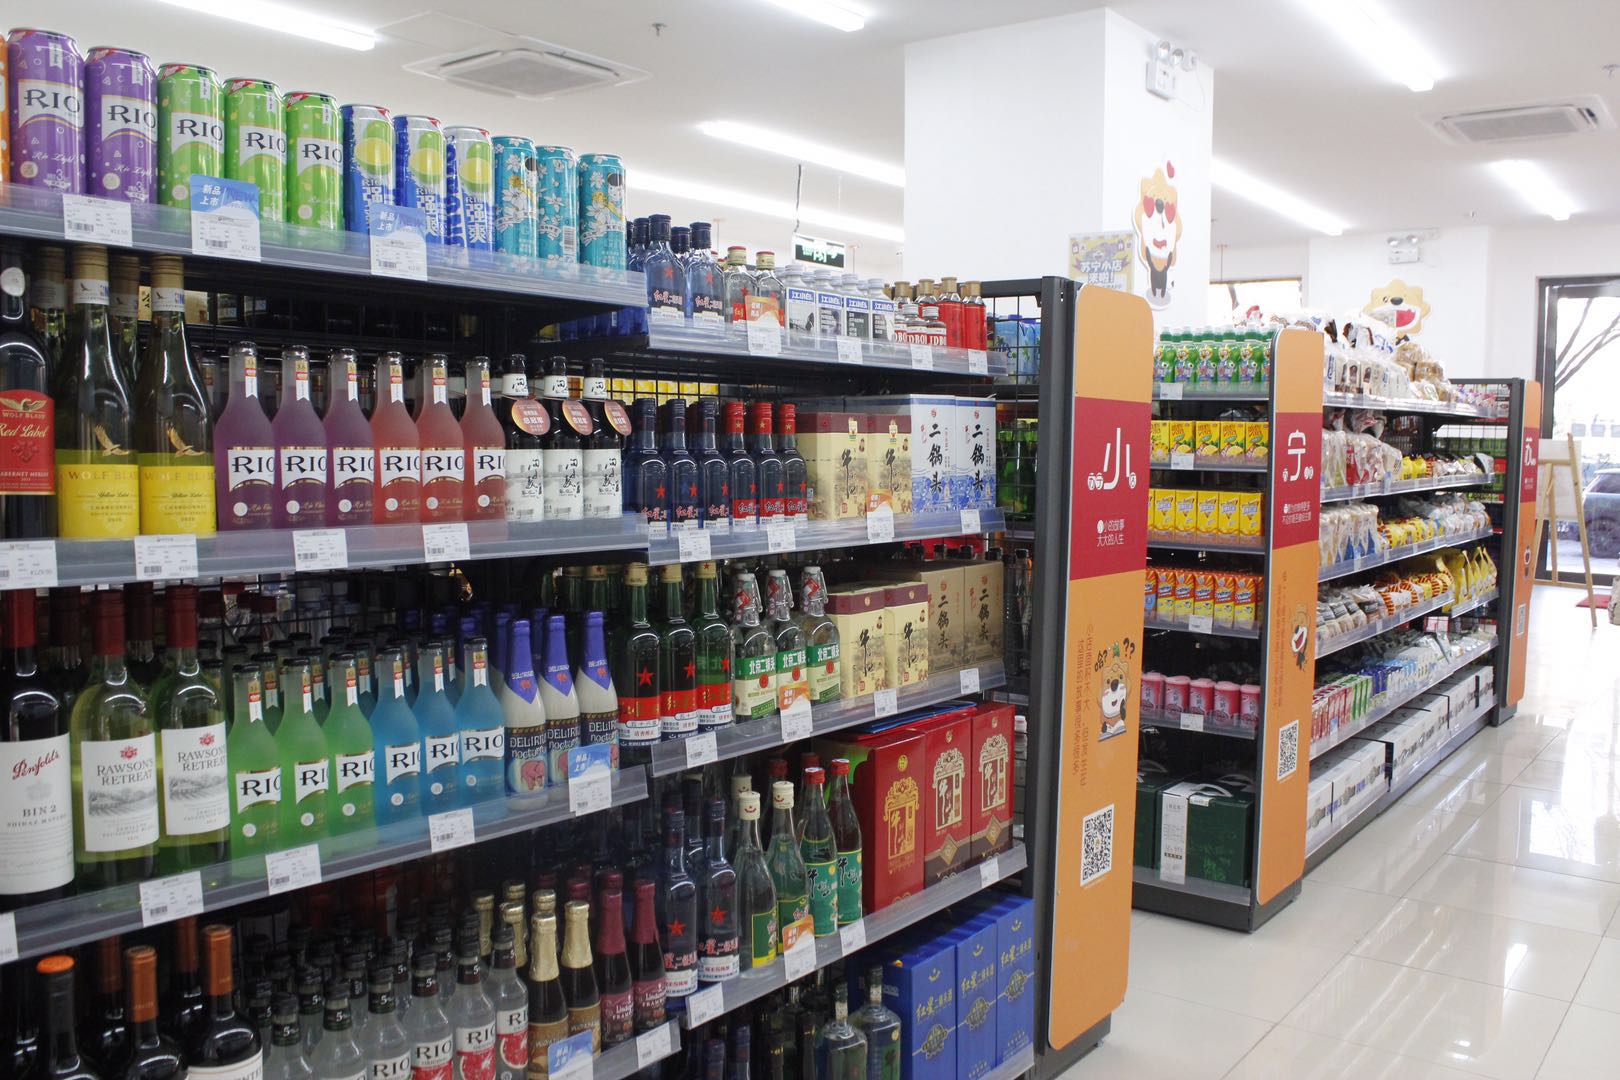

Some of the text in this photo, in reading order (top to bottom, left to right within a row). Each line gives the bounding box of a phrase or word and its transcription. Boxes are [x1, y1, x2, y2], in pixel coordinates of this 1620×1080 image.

[24, 89, 80, 113] RIO
[107, 104, 156, 130] RIO
[177, 119, 223, 142] RIO
[245, 131, 286, 154] RIO
[303, 143, 342, 163] RIO
[201, 183, 221, 196] 新品
[199, 196, 219, 207] 上市
[466, 203, 487, 243] 强爽
[1080, 260, 1123, 272] 苏宁小店
[2, 411, 23, 419] WOLF
[0, 423, 50, 438] Red Label
[232, 456, 275, 474] RIO
[285, 456, 326, 473] RIO
[425, 455, 464, 472] RIO
[928, 423, 943, 494] 二锅头
[970, 424, 985, 492] 二锅头
[937, 594, 950, 650] 二锅头
[978, 588, 990, 642] 二锅头
[464, 733, 504, 753] RIO
[12, 749, 59, 780] Penfolds
[23, 804, 57, 817] BIN 2
[416, 1040, 452, 1059] RIO
[374, 1062, 411, 1078] RIO
